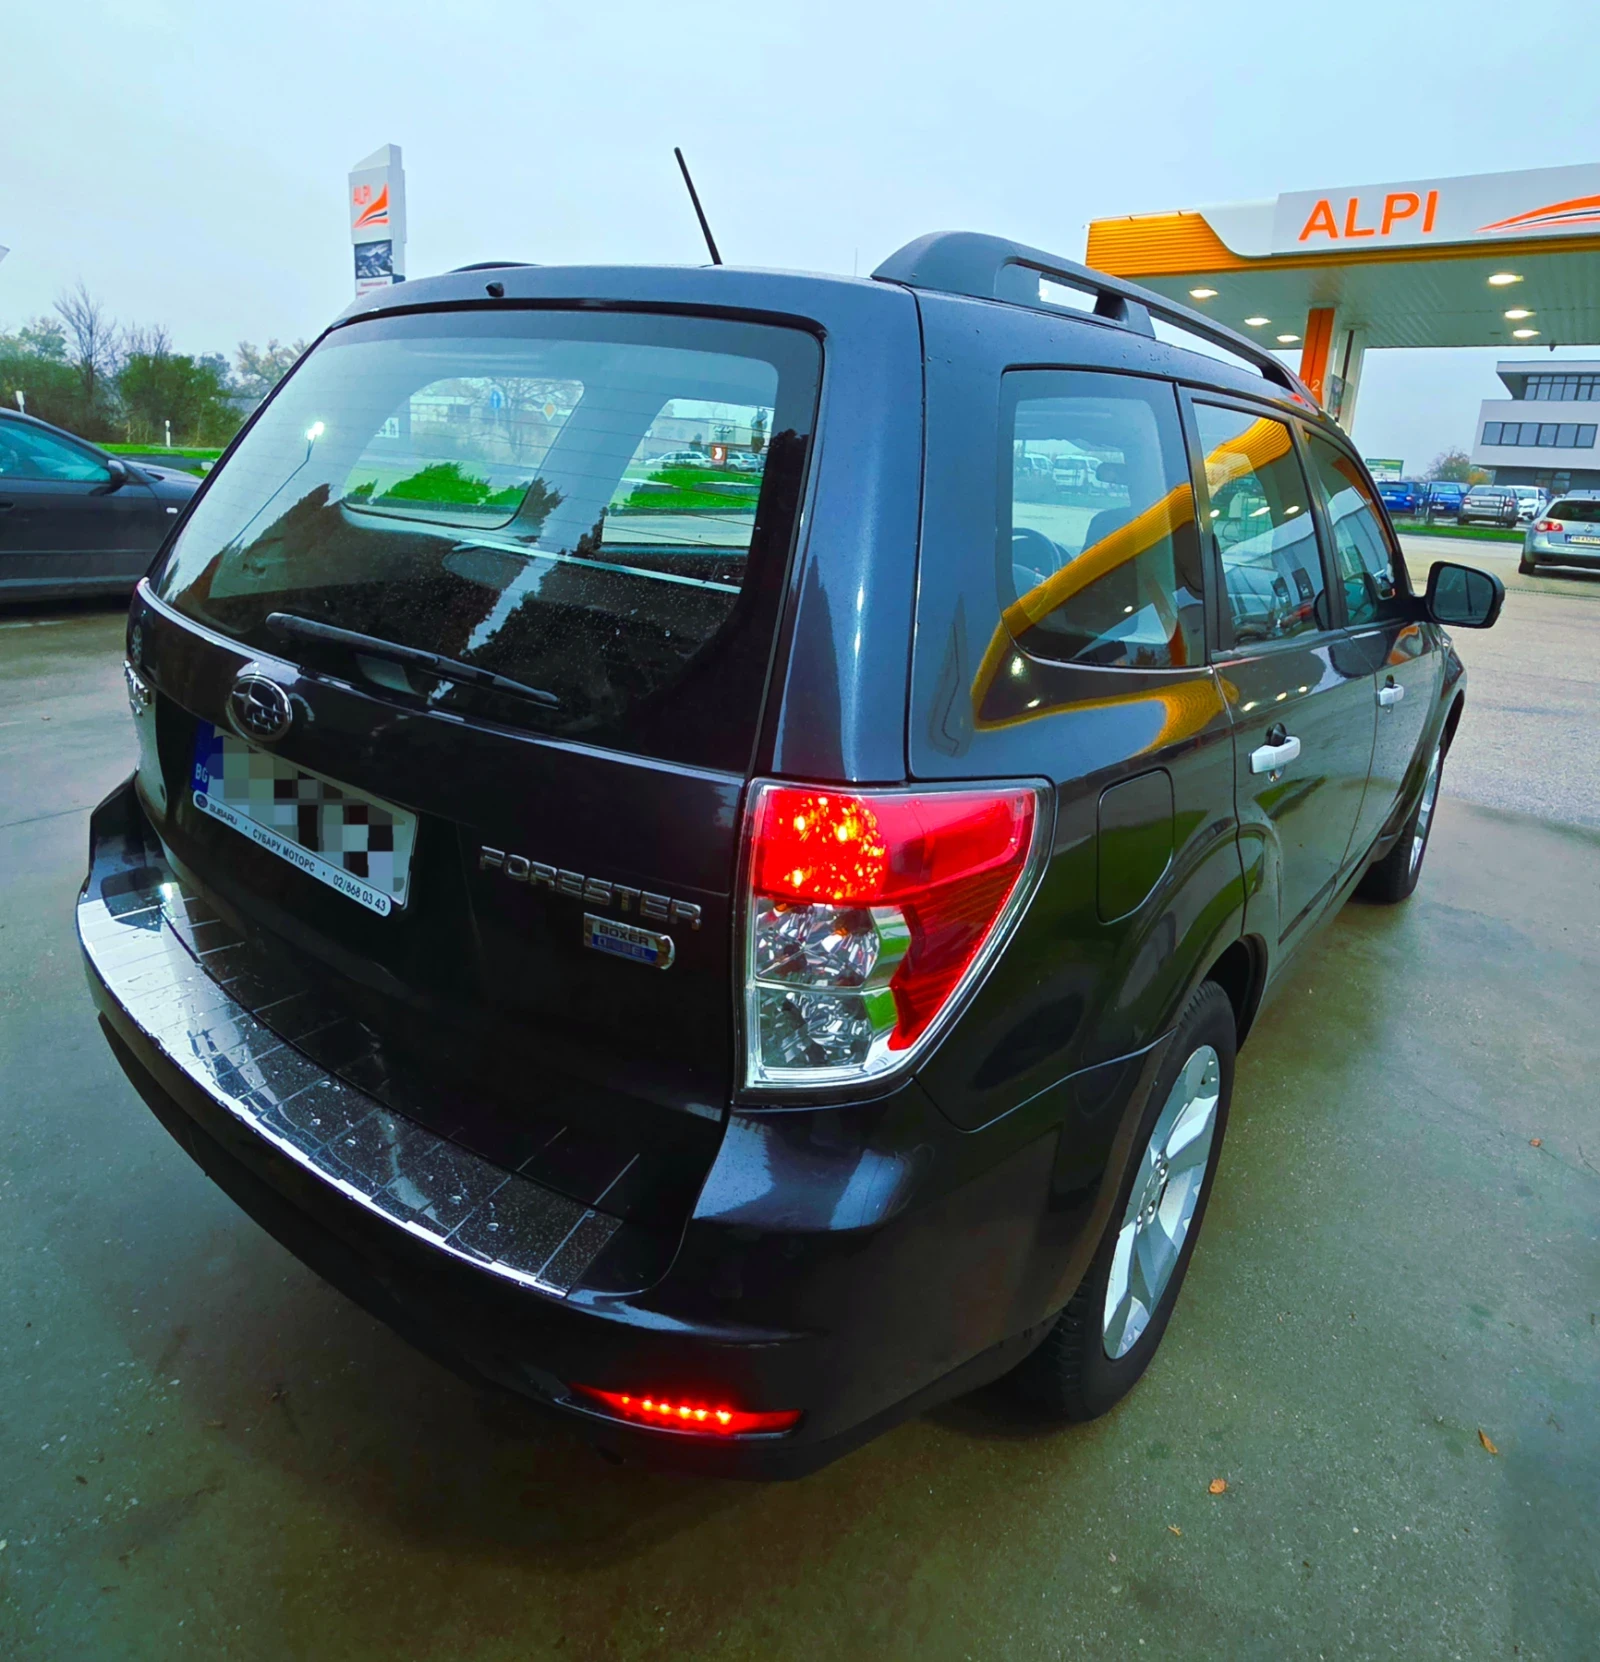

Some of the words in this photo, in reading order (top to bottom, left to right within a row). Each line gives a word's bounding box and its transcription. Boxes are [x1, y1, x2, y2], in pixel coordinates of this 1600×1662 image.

[1298, 189, 1440, 241] ALPI
[195, 763, 208, 783] BG
[209, 803, 238, 825] SUBARU
[253, 829, 281, 851] СУБАРУ
[283, 846, 315, 872] МОТОРС
[333, 874, 361, 898] 02/868
[362, 890, 374, 905] 03
[374, 897, 387, 912] 43
[479, 845, 702, 932] FORESTER
[598, 924, 649, 947] BOXER
[598, 937, 650, 959] DEL
